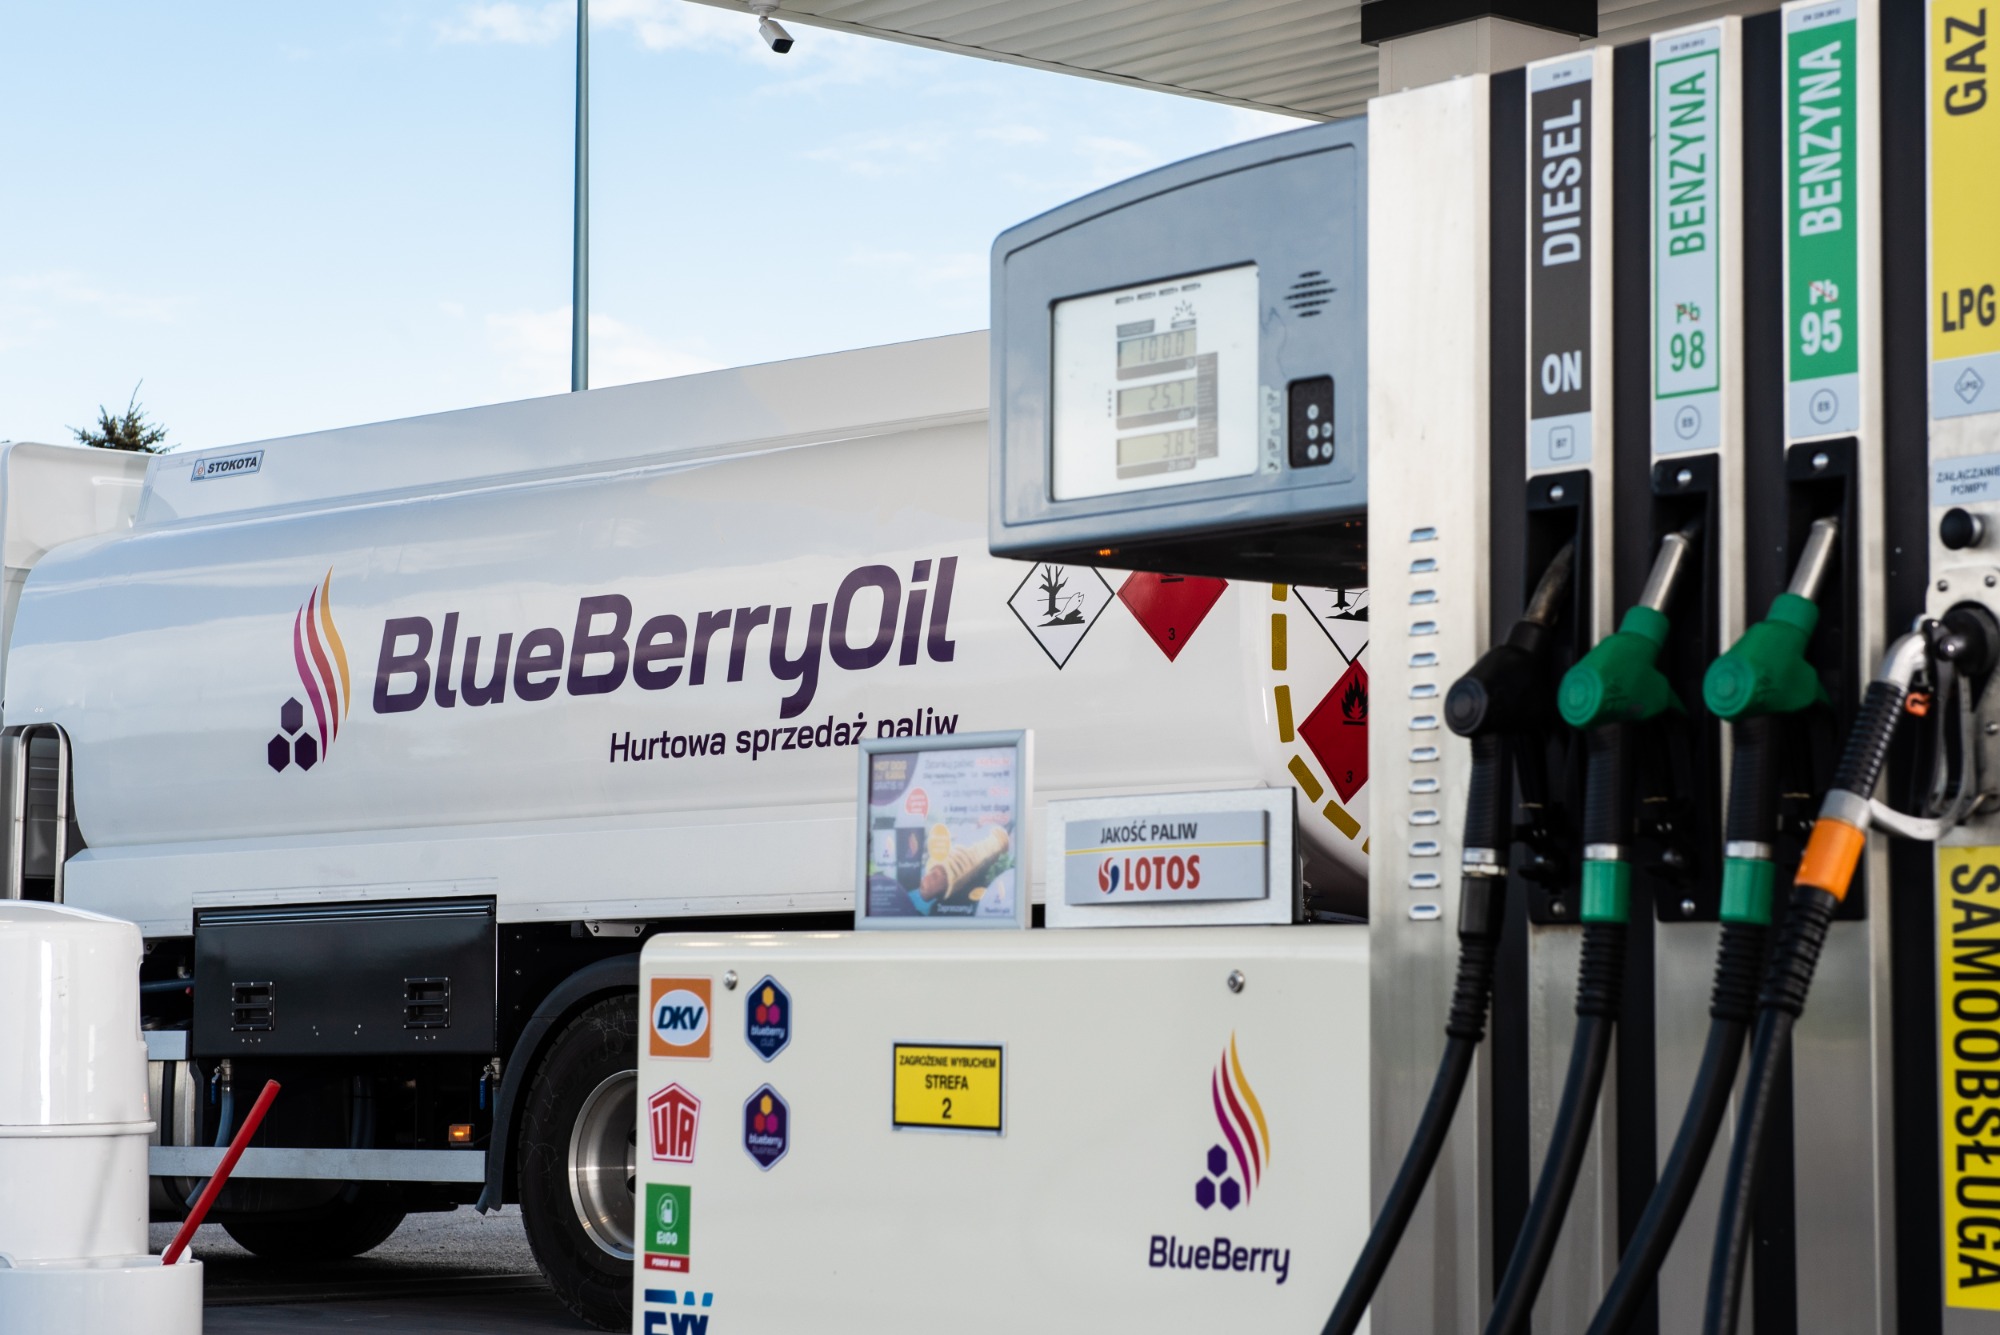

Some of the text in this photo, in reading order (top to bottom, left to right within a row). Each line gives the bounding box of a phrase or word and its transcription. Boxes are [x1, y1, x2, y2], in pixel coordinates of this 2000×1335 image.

[1944, 8, 1987, 116] GAZ
[1799, 40, 1842, 236] BENZYNA
[1542, 98, 1582, 267] DIESEL
[1669, 70, 1706, 256] BENZYNA
[1941, 284, 1996, 333] LPG
[1670, 330, 1706, 373] 98
[1800, 308, 1842, 356] 95
[1541, 350, 1582, 395] ON
[207, 456, 257, 473] STOKOTA
[372, 556, 959, 720] BlueBerryOil
[1168, 627, 1176, 640] 3
[609, 707, 959, 763] Hurtowa sprzedaż paliw
[1345, 770, 1353, 783] 3
[1100, 820, 1198, 844] JAKOŚĆ PALIW
[1124, 854, 1201, 891] LOTOS
[657, 1006, 704, 1030] DKV
[899, 1054, 996, 1068] ZAGROŻENIE WYBUCHEM
[925, 1074, 969, 1090] STREFA
[1950, 863, 2000, 1290] SAMOOBSŁUGA
[652, 1088, 698, 1158] UTA
[942, 1097, 952, 1119] 2
[1149, 1235, 1290, 1285] BlueBerry
